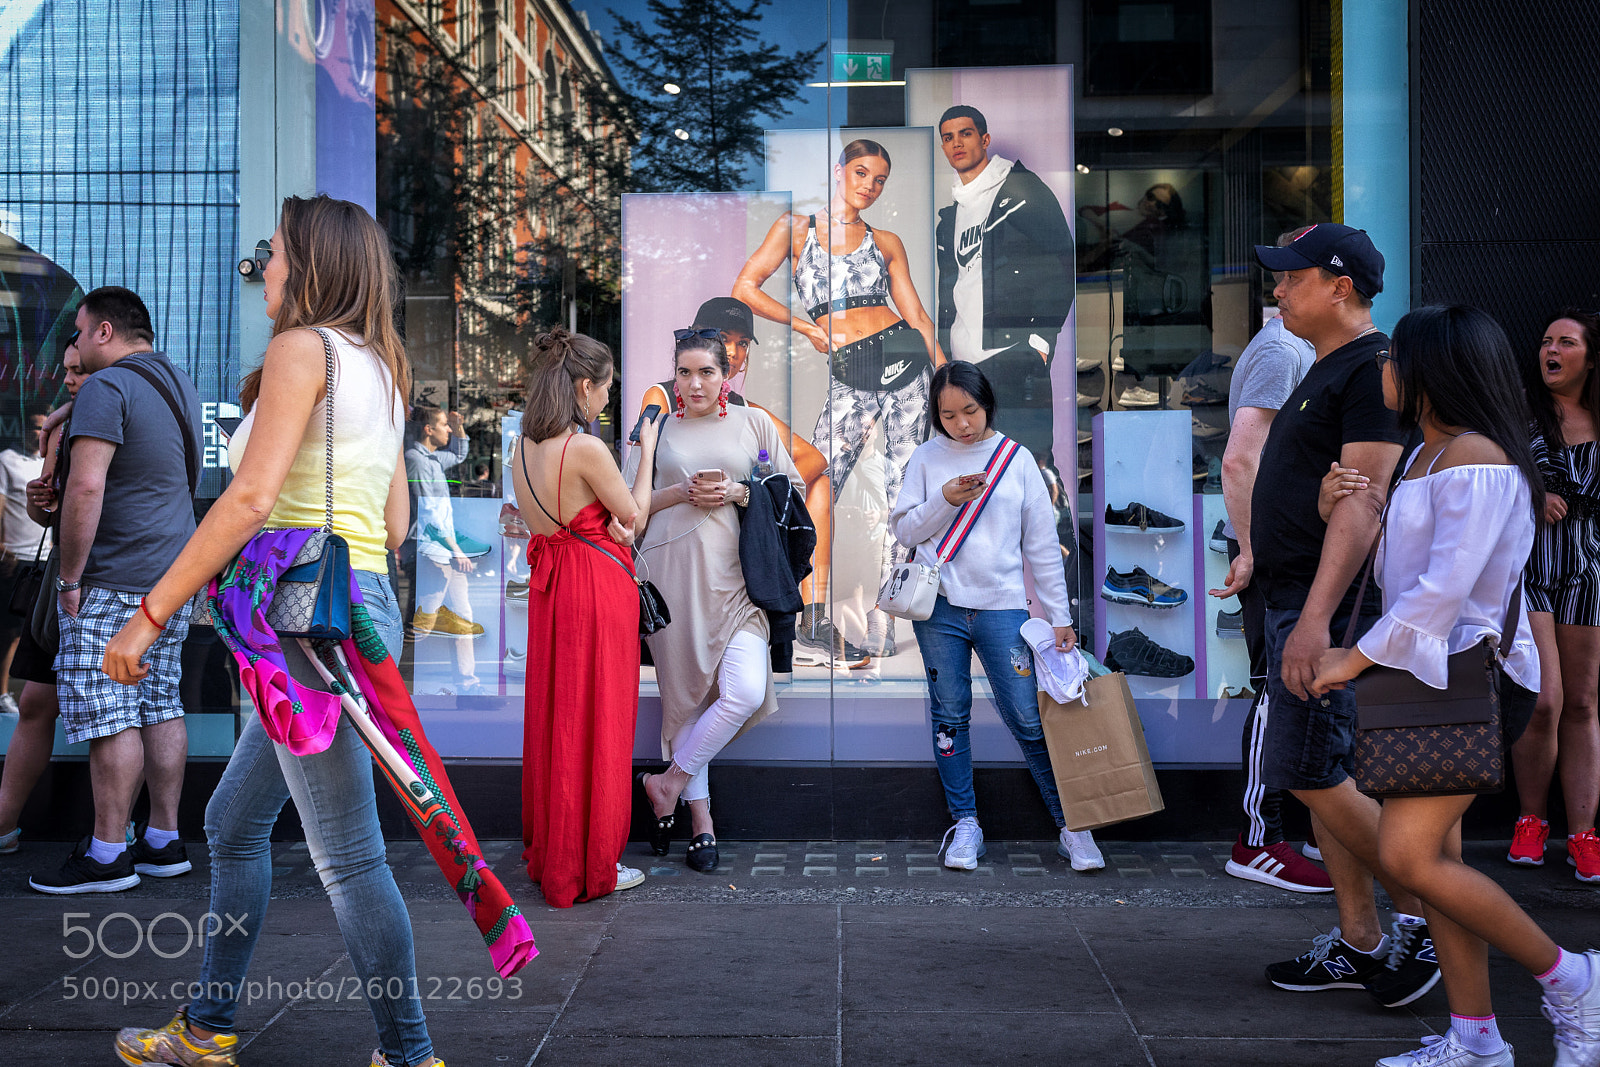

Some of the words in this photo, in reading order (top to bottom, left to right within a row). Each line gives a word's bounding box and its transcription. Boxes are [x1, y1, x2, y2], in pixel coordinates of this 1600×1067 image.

[959, 216, 988, 252] NIK
[884, 359, 905, 378] NIKE
[1074, 744, 1108, 757] NIKE.COM
